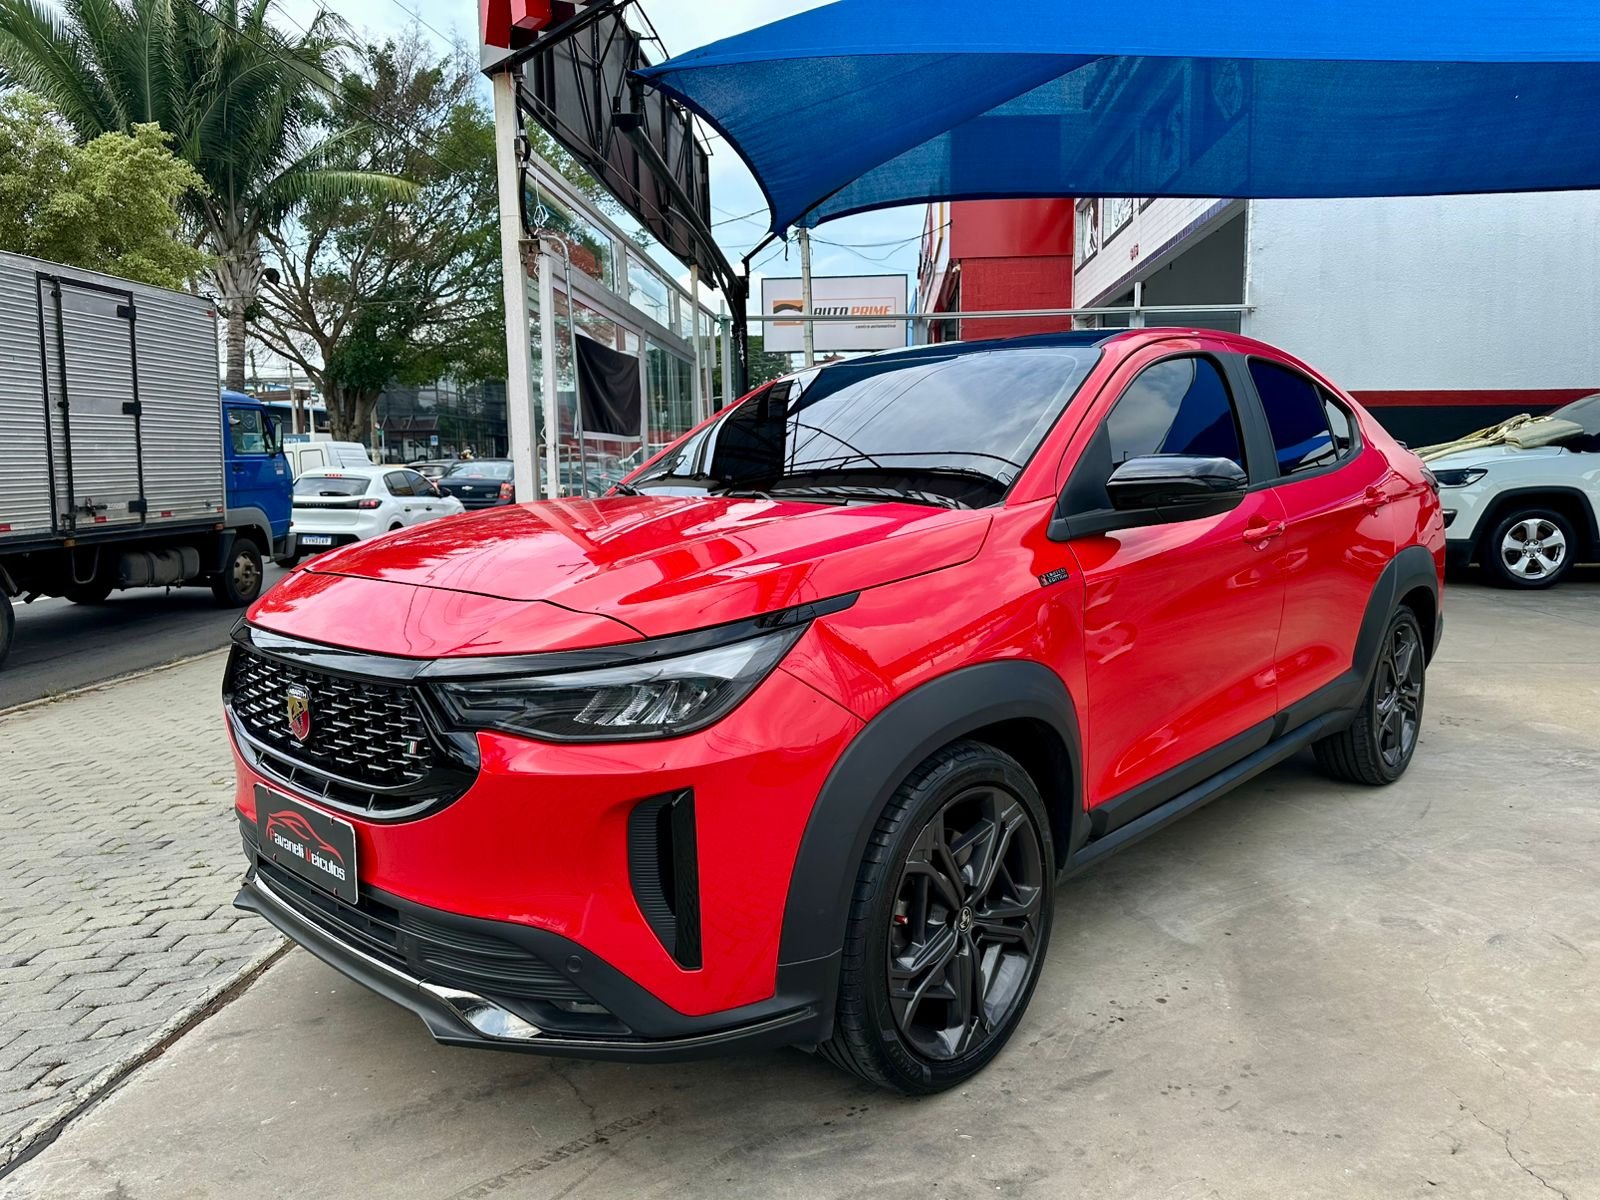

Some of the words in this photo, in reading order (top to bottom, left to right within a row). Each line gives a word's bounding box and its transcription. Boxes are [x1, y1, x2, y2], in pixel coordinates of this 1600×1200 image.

[814, 306, 849, 316] AUTO
[851, 305, 892, 316] PRIME
[288, 688, 307, 698] ABARTH
[305, 847, 346, 881] Veículos
